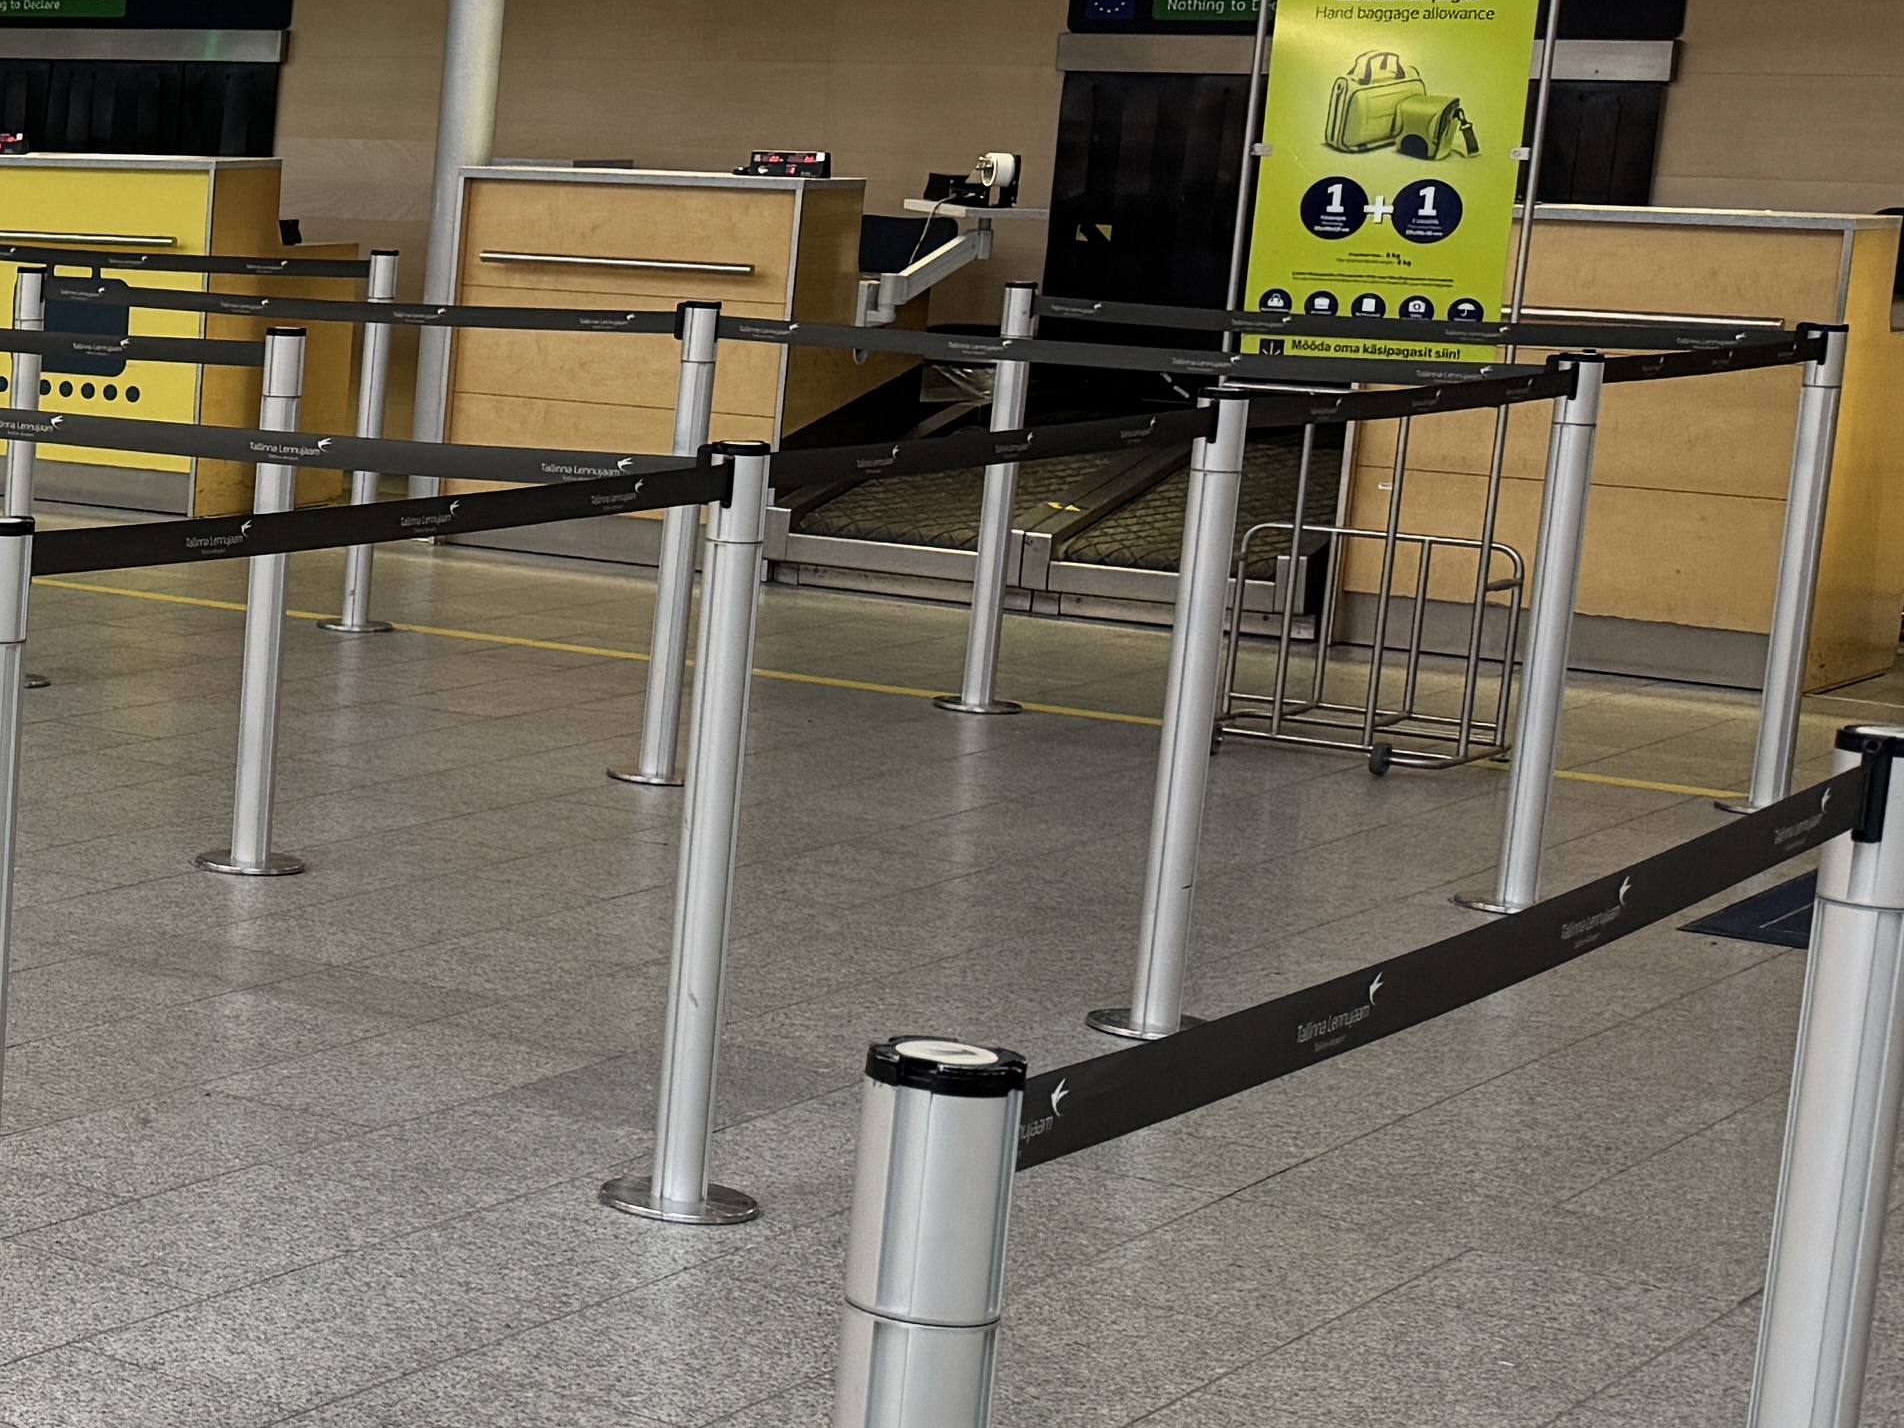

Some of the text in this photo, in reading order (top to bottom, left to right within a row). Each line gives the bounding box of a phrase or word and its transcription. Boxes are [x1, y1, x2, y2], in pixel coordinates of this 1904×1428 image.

[10, 0, 21, 10] to
[1231, 0, 1246, 12] to
[1315, 5, 1496, 23] Hand baggage allowance
[1326, 183, 1437, 216] 1 1
[1292, 339, 1461, 360] Mööda oma käsipagasit siin!
[541, 463, 621, 478] Tallinna Lennujaam
[1297, 1020, 1327, 1044] Tallinna
[1328, 1004, 1370, 1033] Lennujaam
